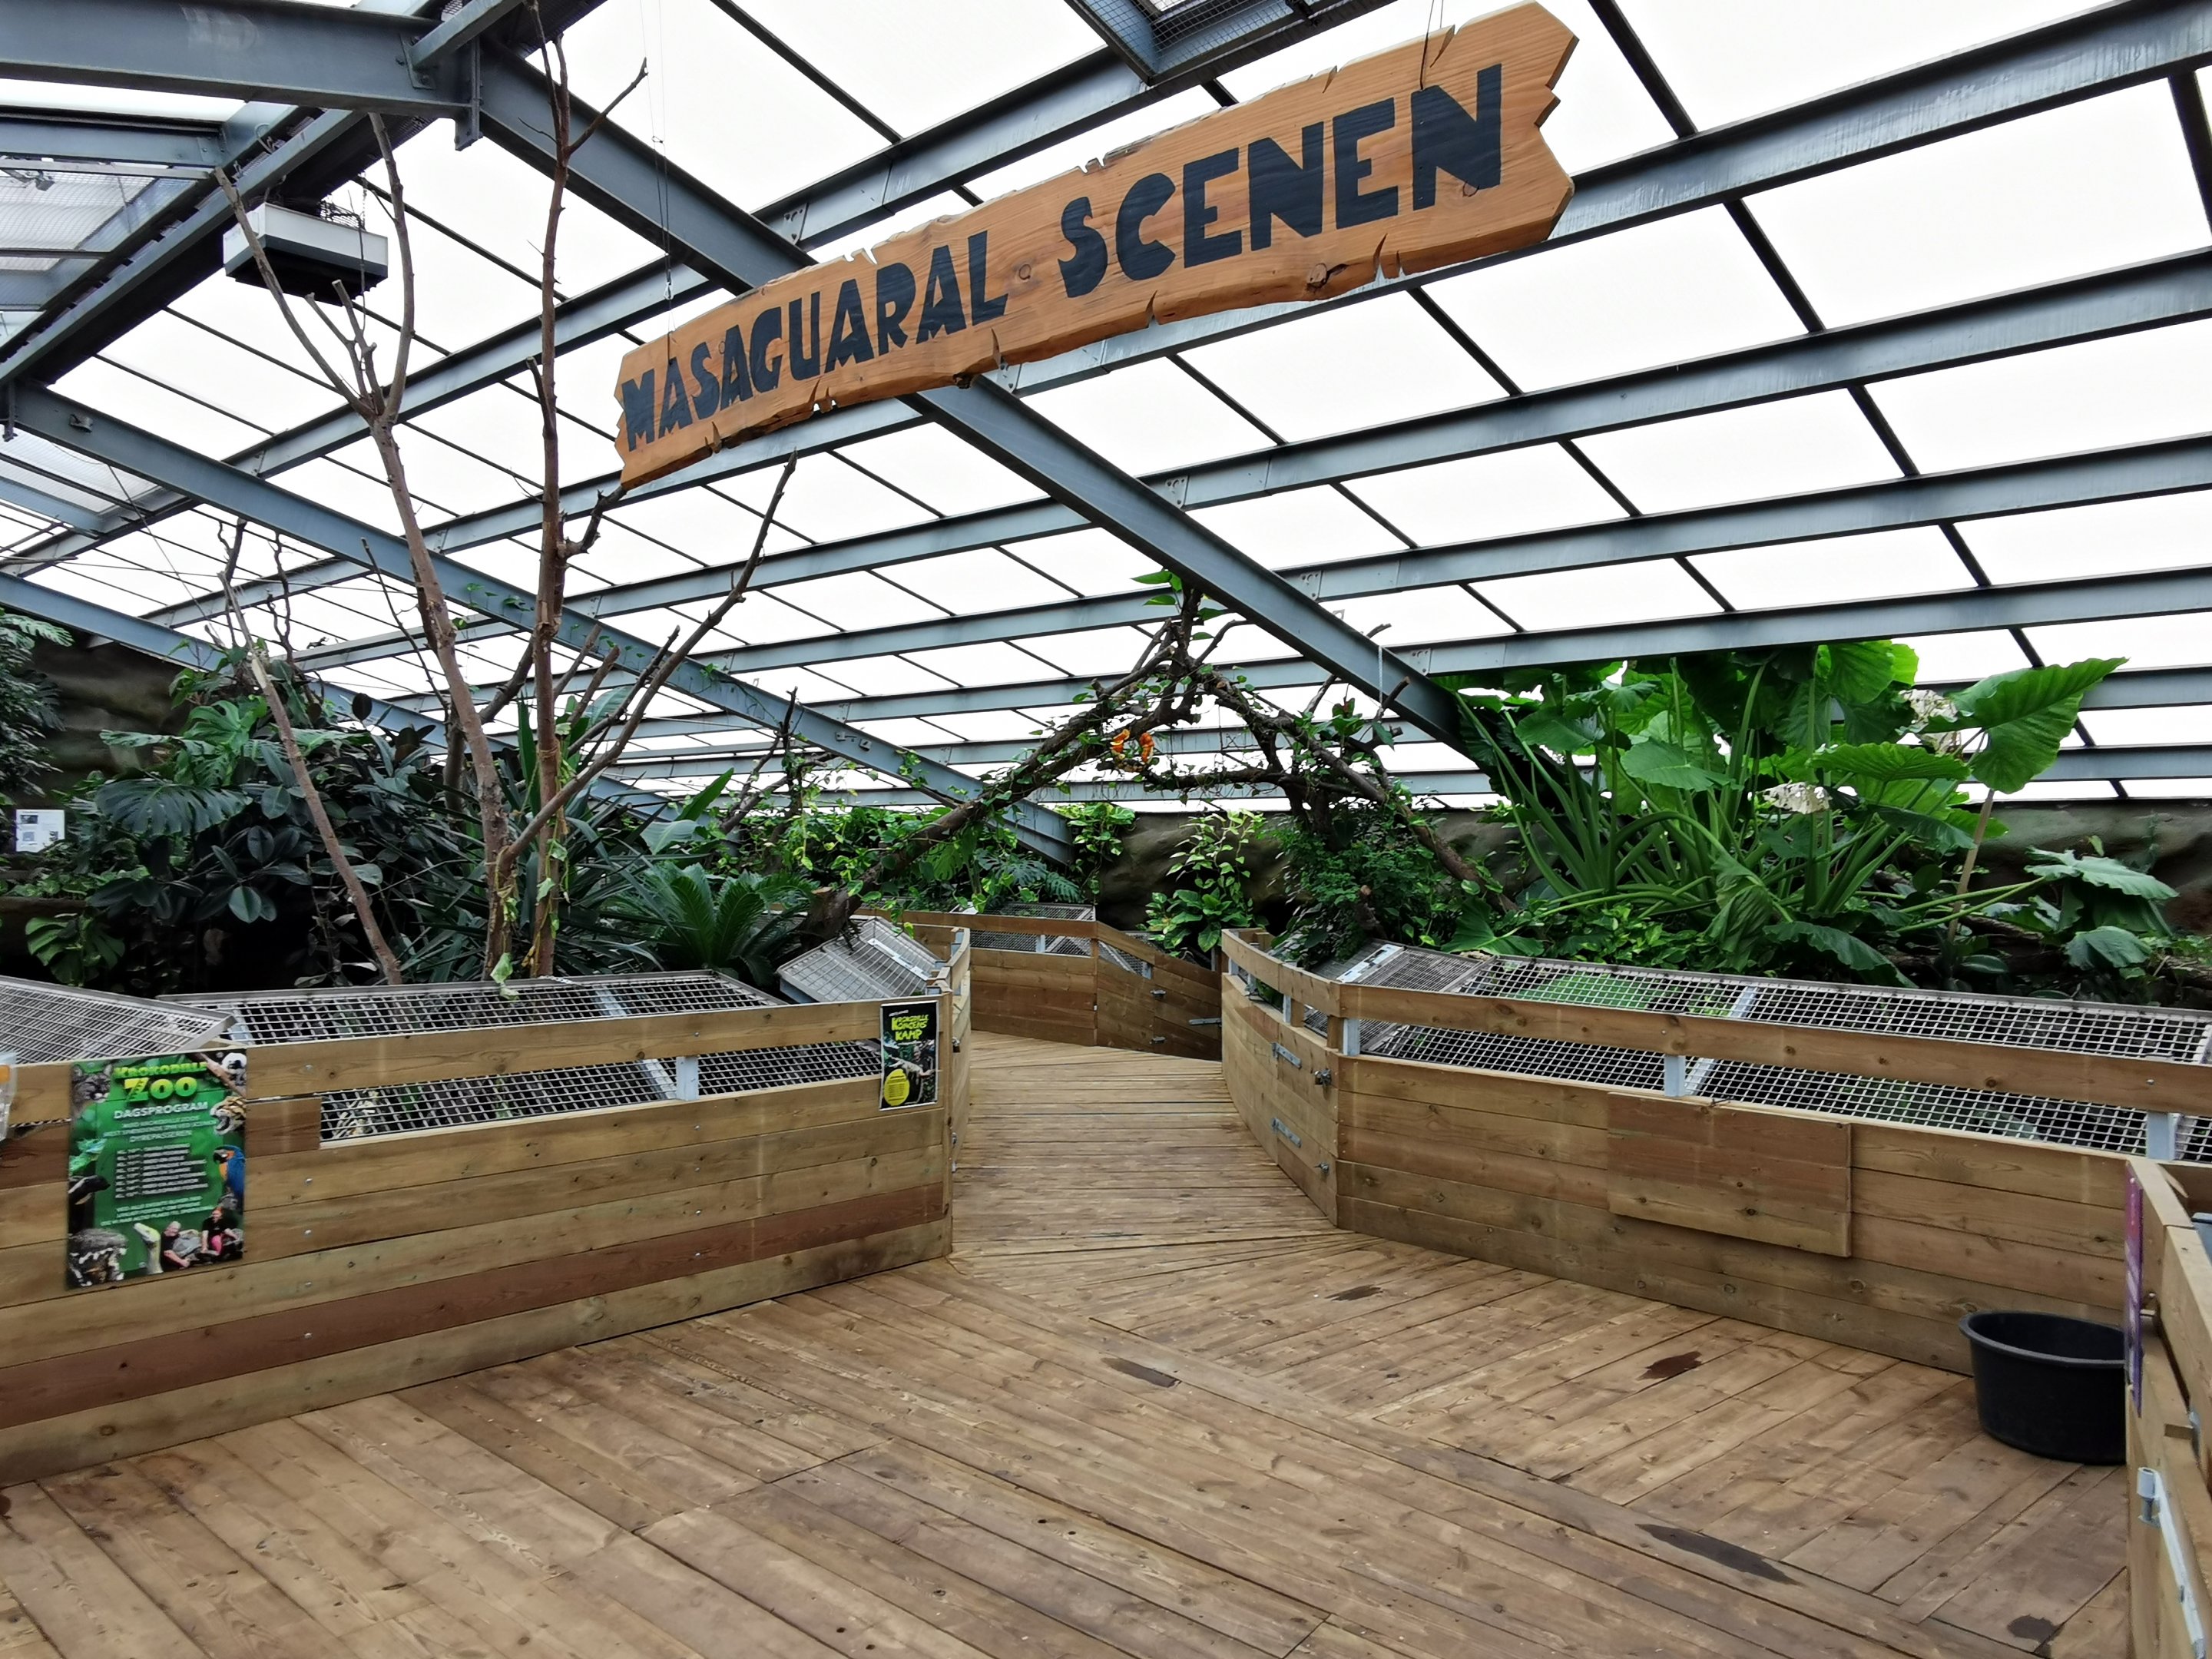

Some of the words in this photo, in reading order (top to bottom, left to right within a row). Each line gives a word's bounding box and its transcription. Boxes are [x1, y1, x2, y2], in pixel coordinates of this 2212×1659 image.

[621, 230, 1009, 452] MASAGUARAL
[1057, 63, 1503, 300] SCENEN
[896, 1028, 922, 1041] KAMP
[124, 1077, 197, 1102] ZOO
[114, 1101, 208, 1119] DAGSPROGRAM
